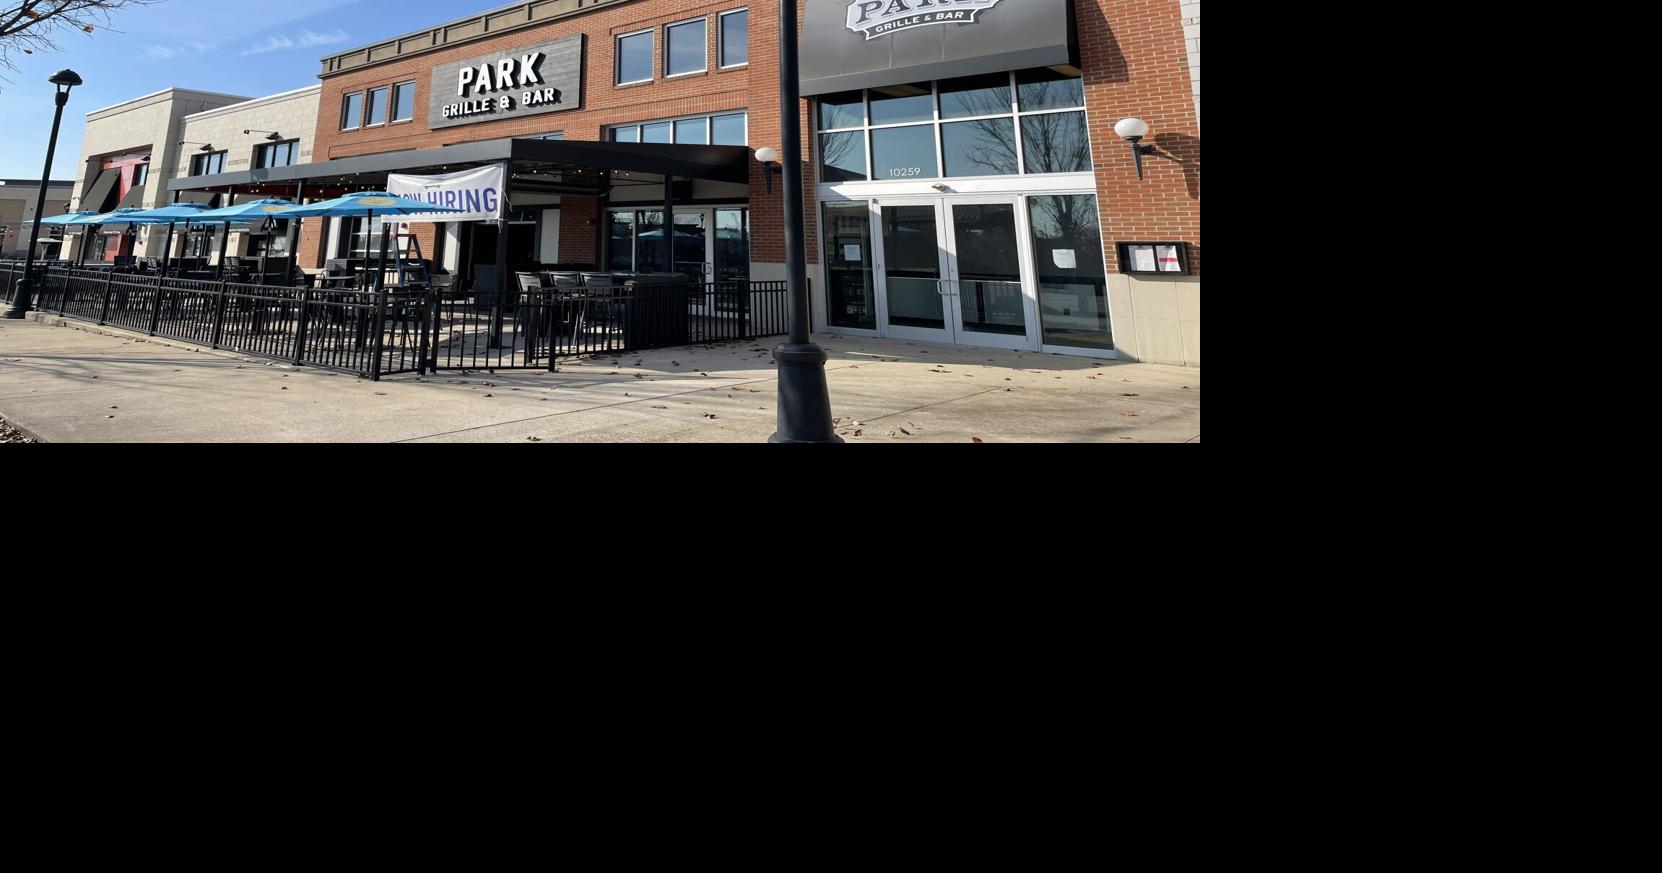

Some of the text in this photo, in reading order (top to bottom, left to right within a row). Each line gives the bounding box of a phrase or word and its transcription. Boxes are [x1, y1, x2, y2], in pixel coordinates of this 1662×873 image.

[875, 11, 964, 33] GRILLE & BAR
[457, 52, 541, 96] PARK
[442, 87, 555, 117] GRILLE & BAR
[889, 167, 921, 177] 10259
